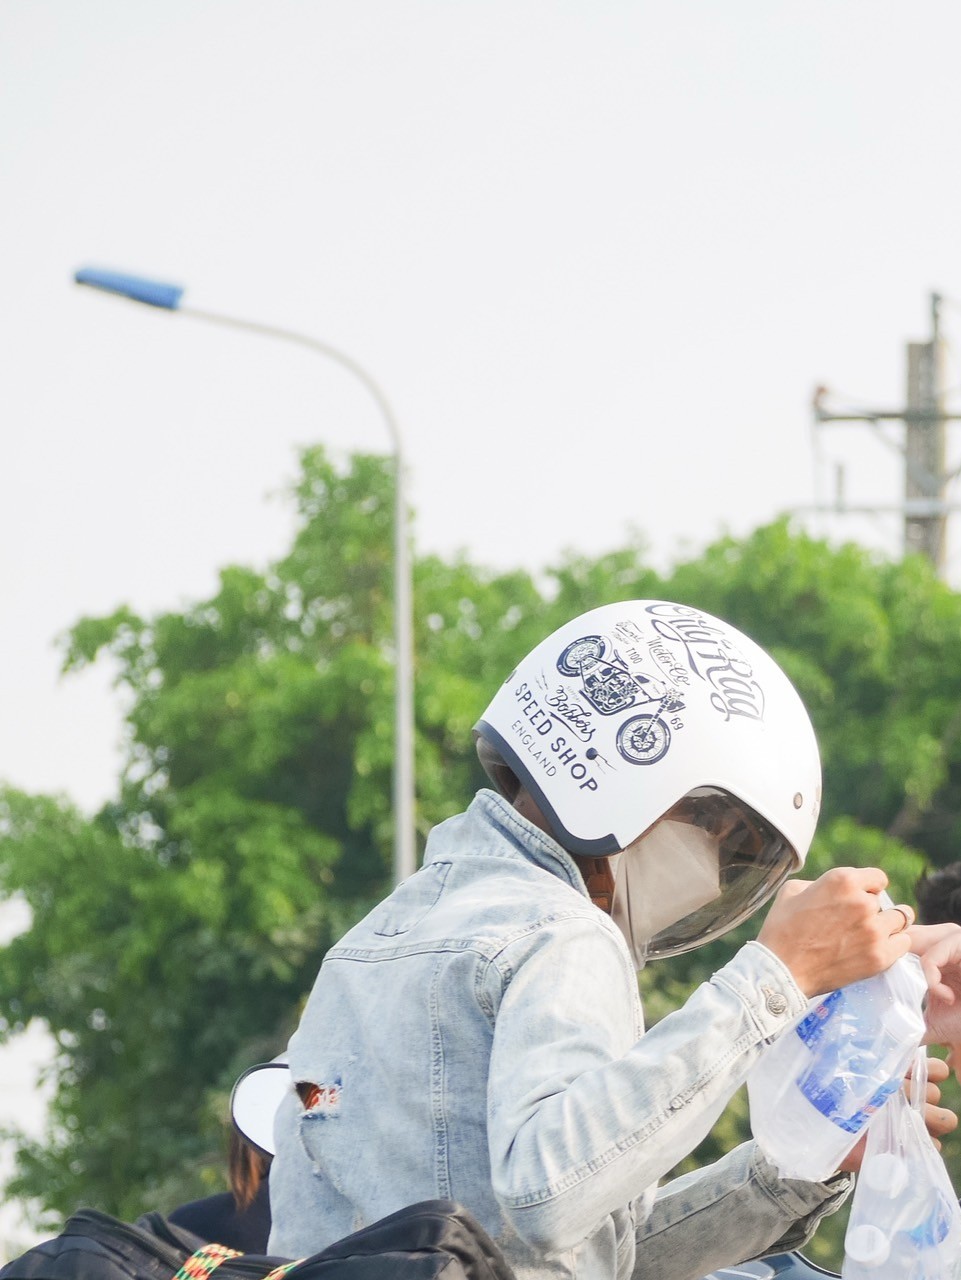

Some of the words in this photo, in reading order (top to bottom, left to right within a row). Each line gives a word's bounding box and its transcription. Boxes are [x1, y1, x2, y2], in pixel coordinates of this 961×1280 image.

[626, 647, 643, 664] T100
[515, 683, 553, 736] SPEED
[551, 737, 598, 791] SHOP
[545, 685, 596, 742] Bobbers
[511, 720, 557, 777] ENGLAND
